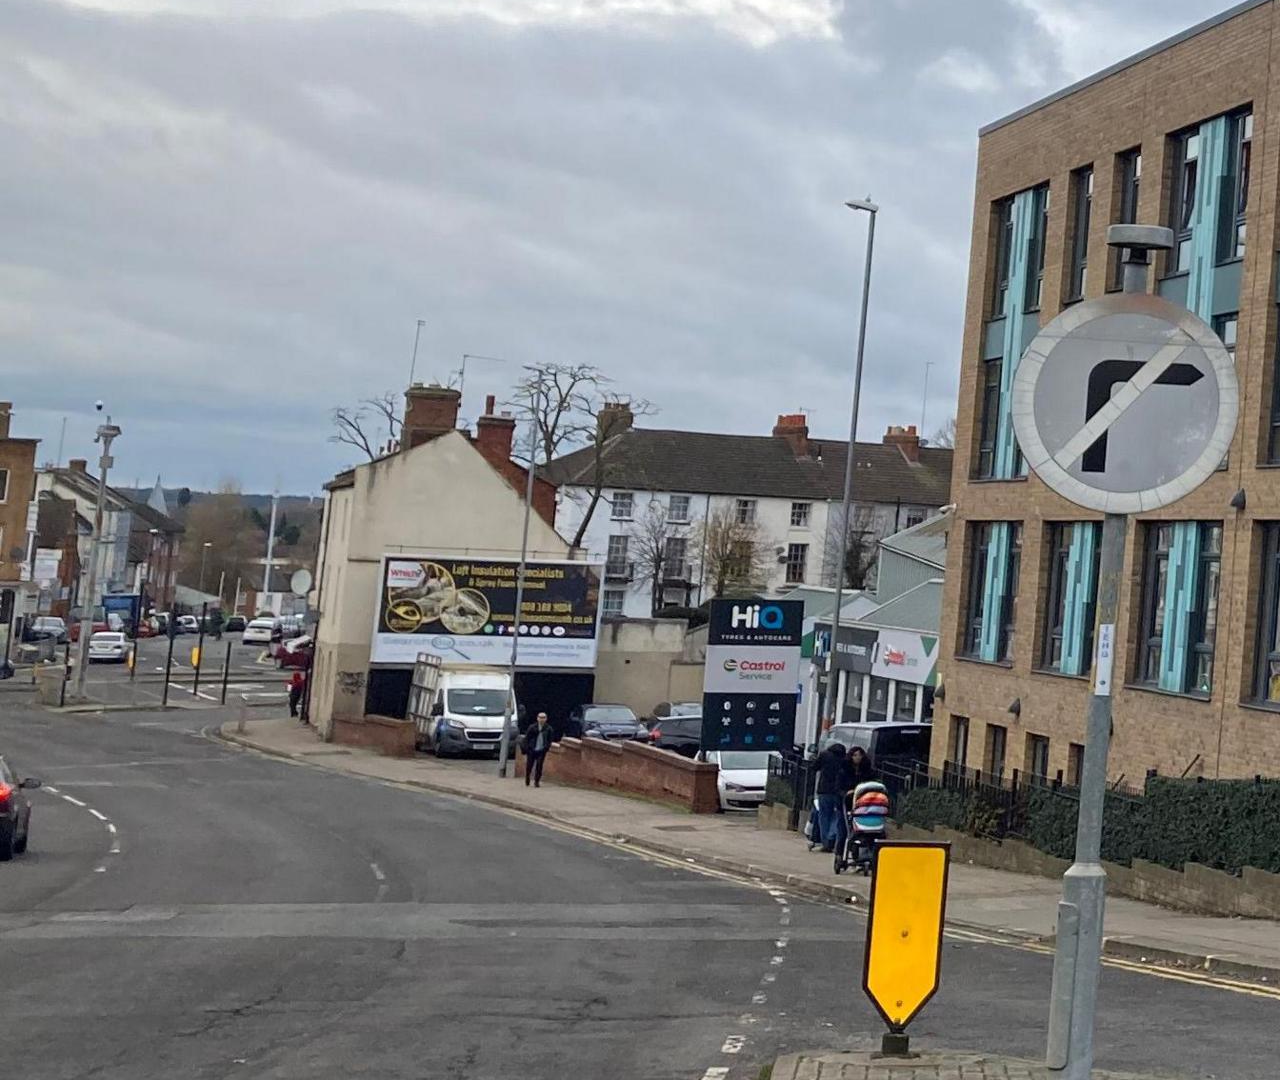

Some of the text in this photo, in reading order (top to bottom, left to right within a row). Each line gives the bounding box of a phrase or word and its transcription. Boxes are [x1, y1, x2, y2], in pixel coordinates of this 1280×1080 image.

[731, 604, 785, 629] HiQ
[739, 660, 786, 671] Castrol
[739, 672, 773, 681] Service
